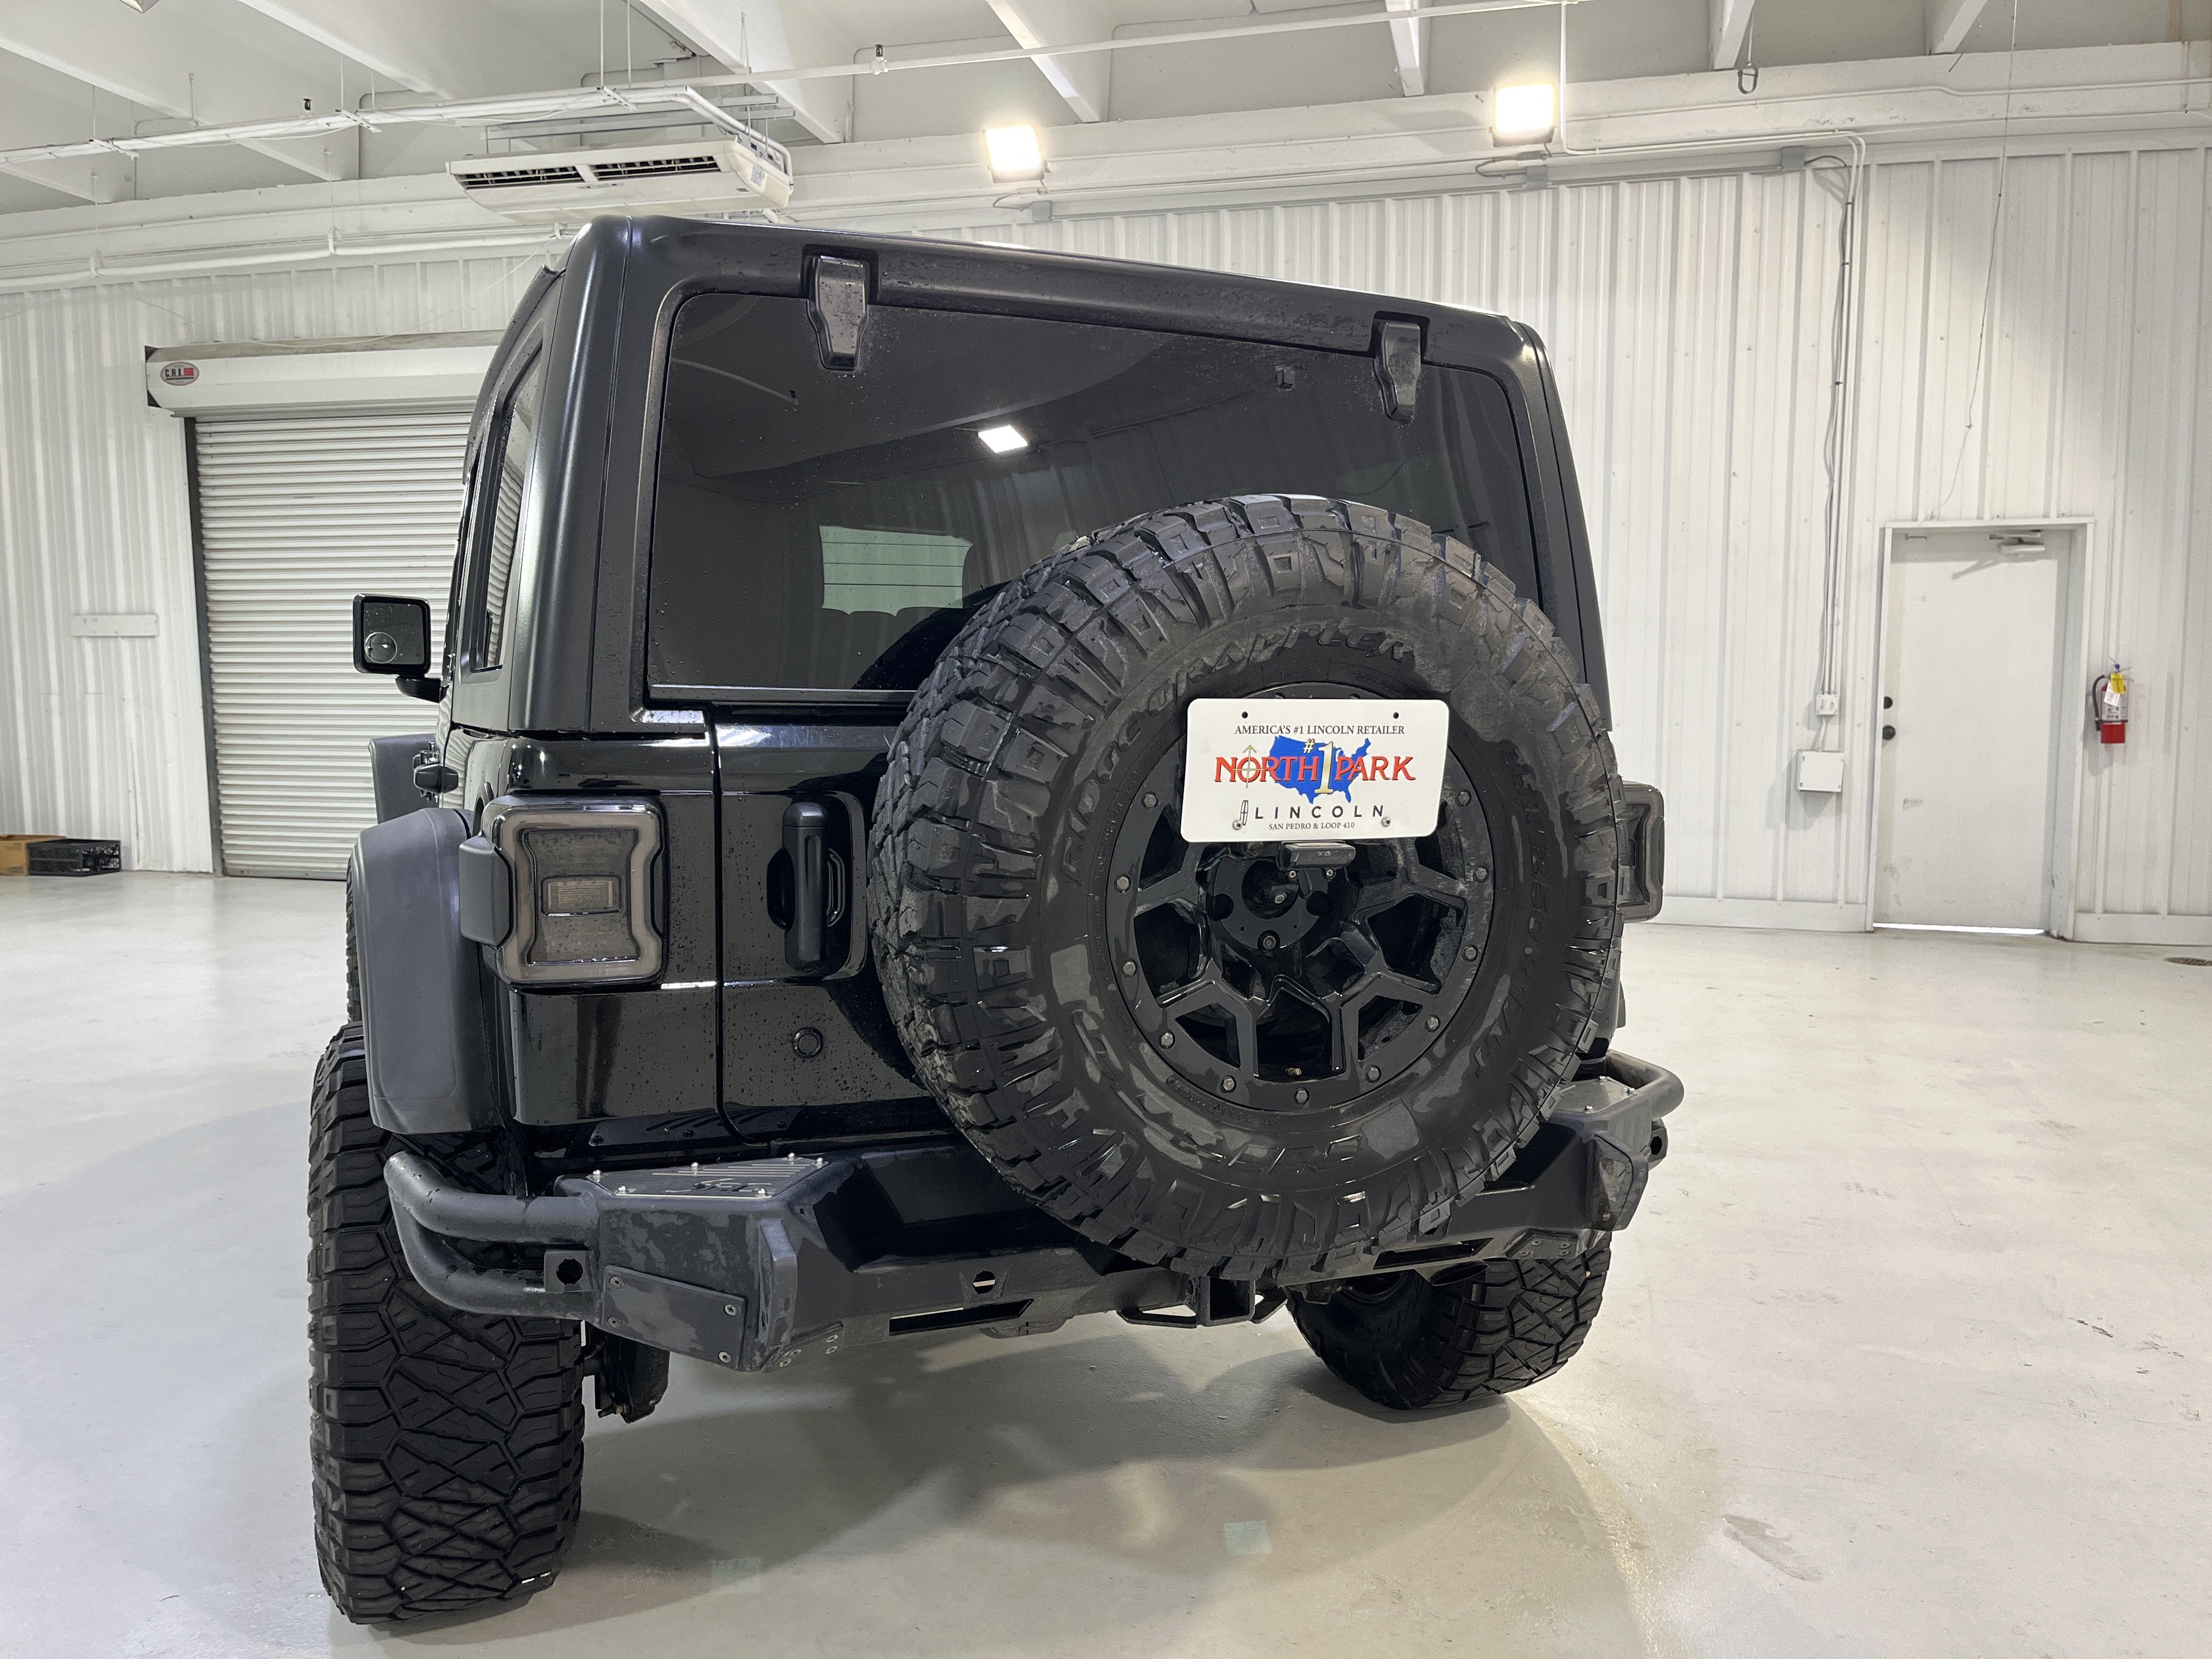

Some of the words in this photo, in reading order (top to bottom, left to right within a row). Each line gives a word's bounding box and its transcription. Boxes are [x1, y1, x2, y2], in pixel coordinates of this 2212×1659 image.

[1234, 725, 1291, 734] AMERICA'S
[1293, 725, 1304, 734] #1
[1307, 725, 1355, 735] LINCOLN
[1357, 725, 1405, 734] RETAILER
[1214, 756, 1319, 782] NORTH
[1335, 756, 1417, 781] PARK
[1255, 805, 1383, 819] LINCOLN
